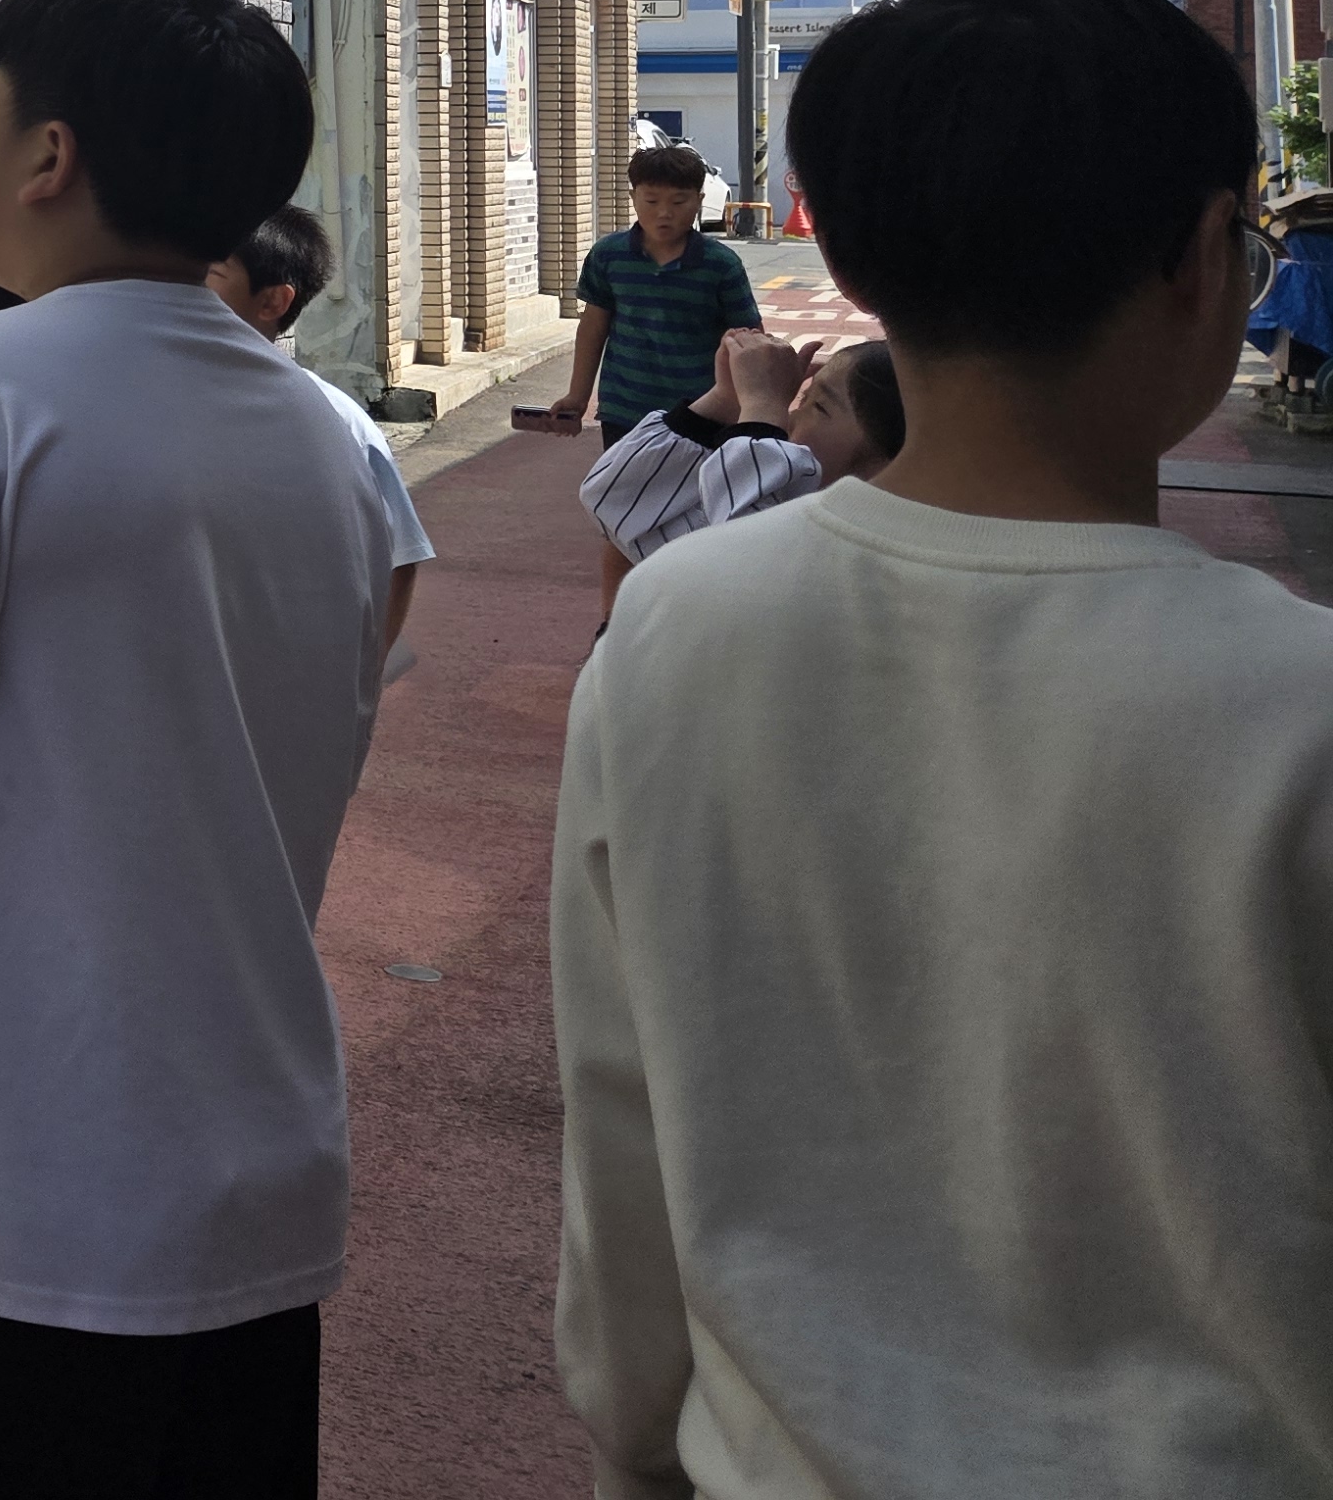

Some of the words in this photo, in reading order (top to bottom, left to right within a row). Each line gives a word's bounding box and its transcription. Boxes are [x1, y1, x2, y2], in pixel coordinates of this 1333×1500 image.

[641, 2, 656, 14] 제
[769, 23, 803, 34] essert
[805, 22, 831, 33] Islan
